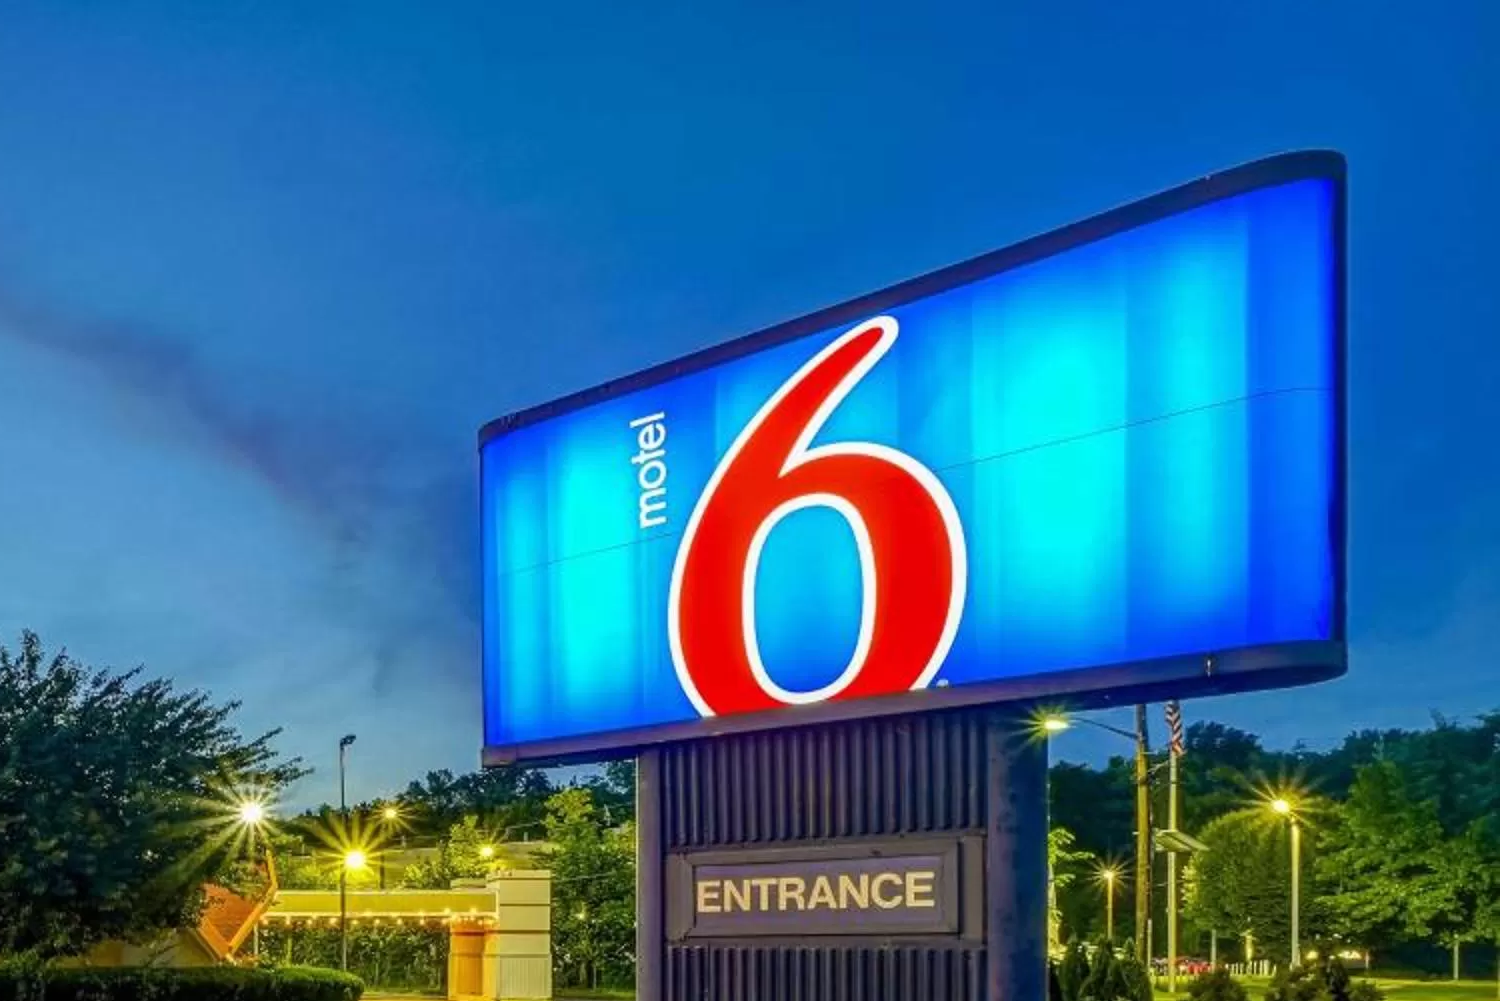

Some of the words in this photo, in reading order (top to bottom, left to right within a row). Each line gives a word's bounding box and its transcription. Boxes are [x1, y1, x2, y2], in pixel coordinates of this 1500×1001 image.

[630, 411, 666, 529] motel
[667, 315, 967, 717] 6
[696, 871, 935, 913] ENTRANCE
